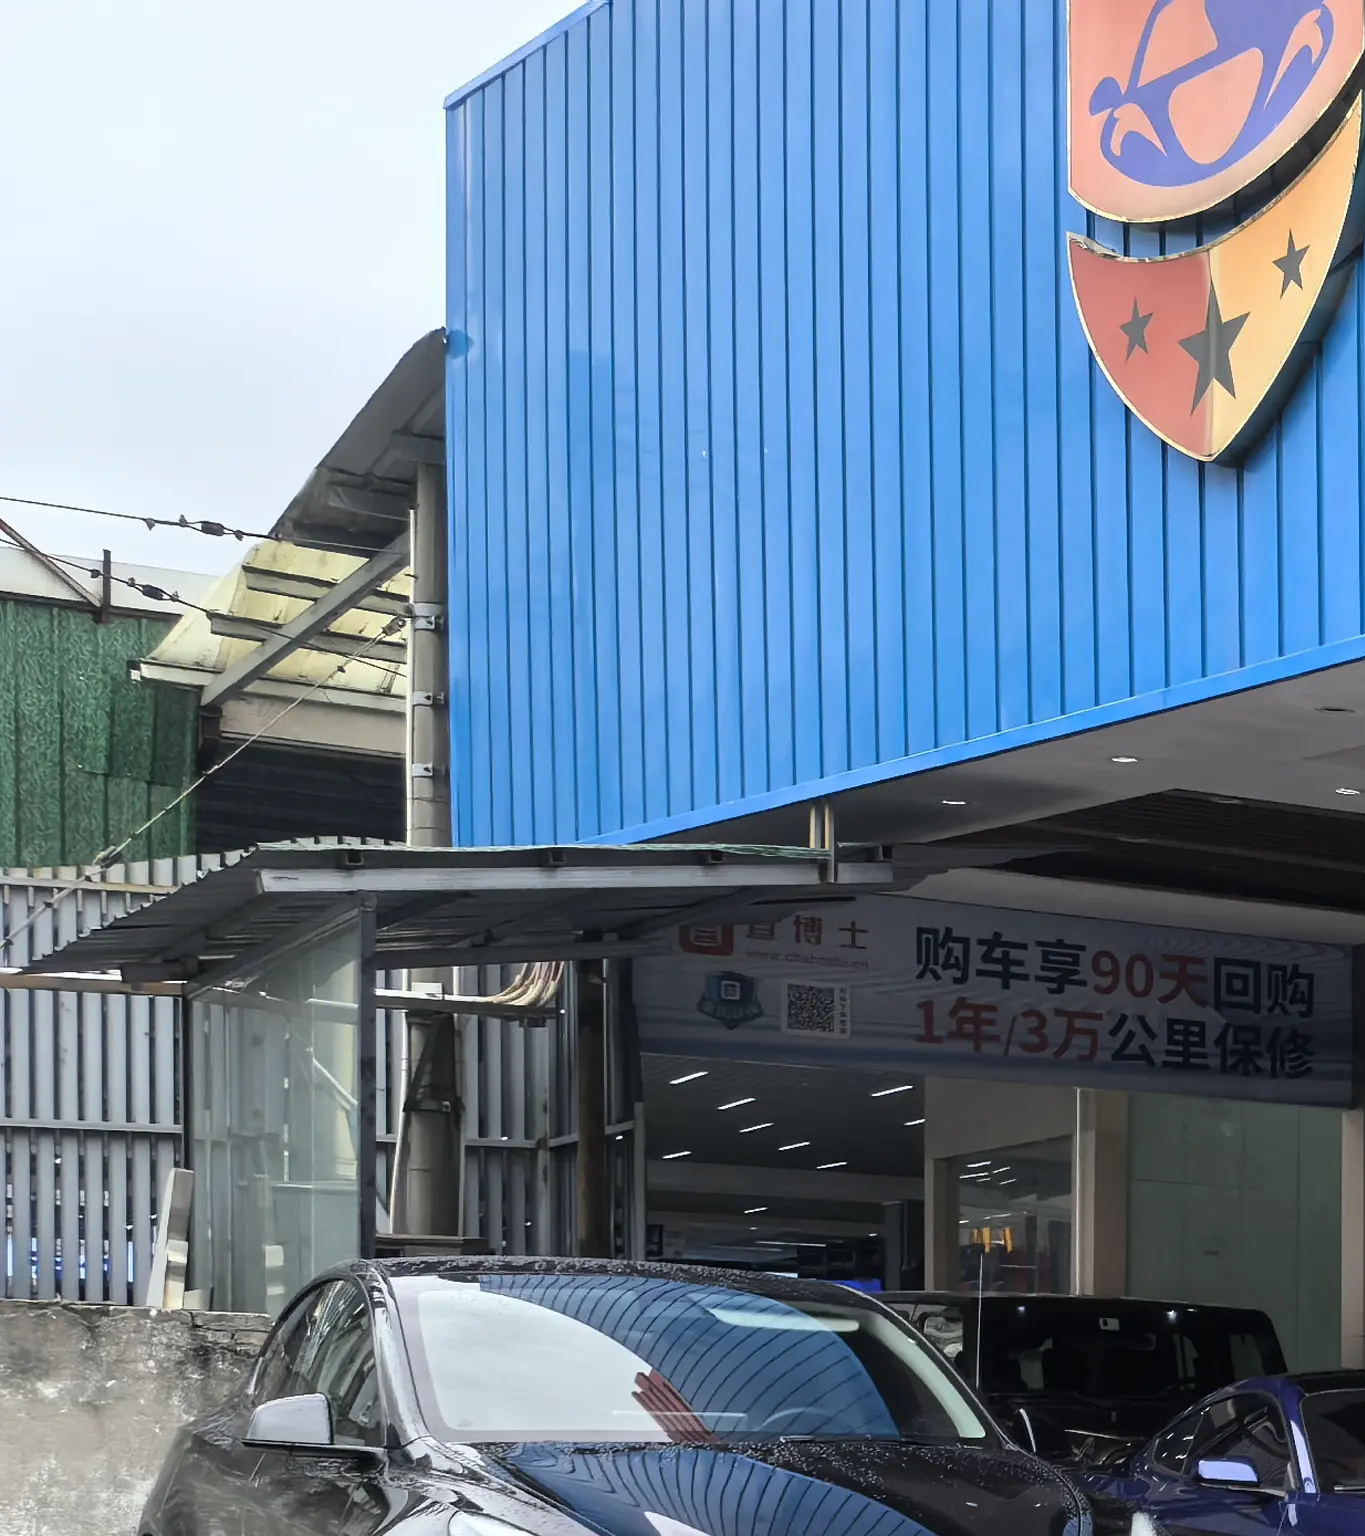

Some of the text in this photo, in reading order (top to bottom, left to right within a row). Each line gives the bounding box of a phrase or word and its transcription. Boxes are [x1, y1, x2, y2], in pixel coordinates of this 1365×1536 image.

[914, 925, 1316, 1020] 购车享90天回购
[913, 995, 1316, 1080] 1年/3万公里保修
